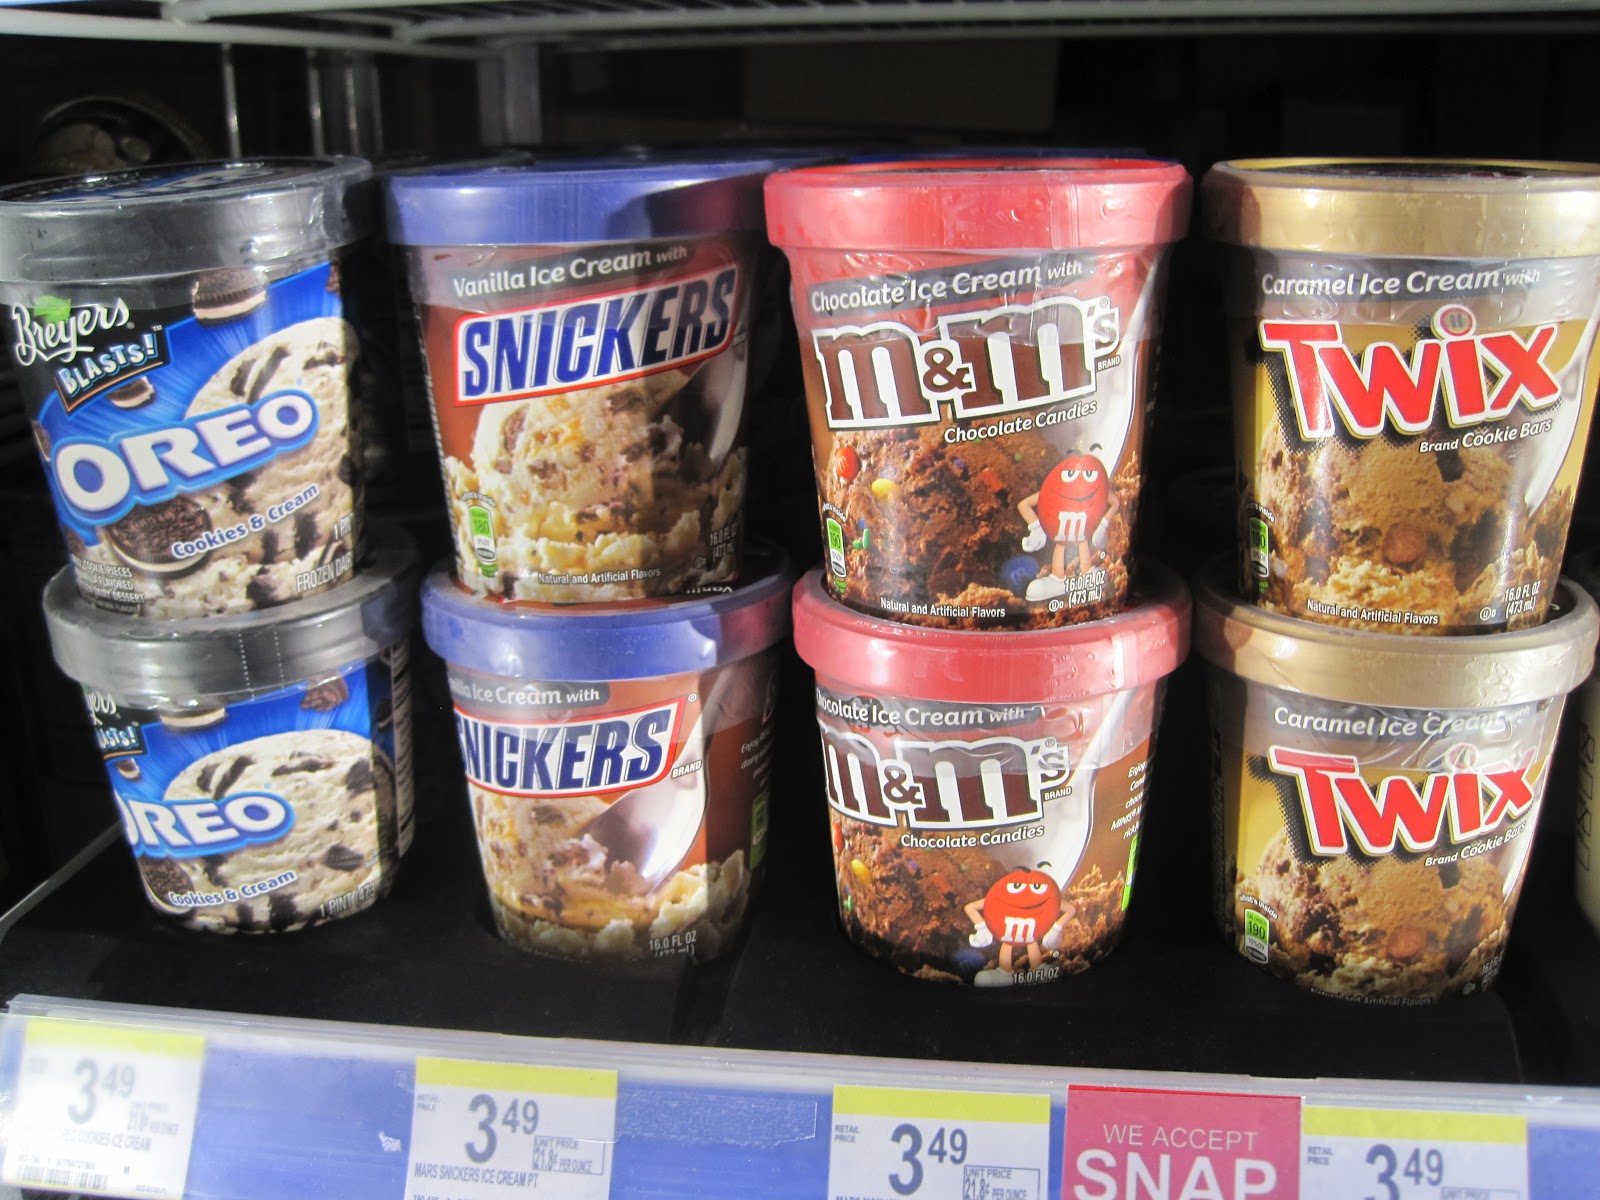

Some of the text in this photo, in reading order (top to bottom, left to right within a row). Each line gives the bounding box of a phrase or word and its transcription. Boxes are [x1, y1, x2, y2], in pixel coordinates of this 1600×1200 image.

[453, 246, 687, 298] Vanilla Ice Cream with
[1262, 269, 1541, 296] Caramel Ice Cream with
[812, 259, 1082, 313] Chocolate Ice Cream with
[11, 298, 129, 366] Breyers
[463, 268, 733, 397] SNICKERS
[1097, 355, 1121, 371] BRAND
[944, 401, 1097, 444] Chocolate Candies
[1419, 418, 1552, 454] Brand Cookie Bars
[56, 394, 313, 512] OREO
[173, 484, 318, 559] Cookies & Cream
[296, 562, 335, 593] FROZEN
[538, 567, 661, 585] Natural and Artificial Flavors
[1065, 570, 1105, 592] 16.0 FL OZ
[1069, 590, 1086, 608] (473
[1505, 580, 1541, 601] 16.0 FL OZ
[880, 597, 1006, 618] Natural and Artificial Flavors
[1307, 598, 1439, 625] Natural and Artificial Flavors
[1506, 600, 1523, 619] (473
[472, 683, 493, 702] Ice
[495, 687, 562, 704] Cream
[566, 689, 600, 702] with
[872, 705, 900, 724] Ice
[905, 707, 983, 726] Cream
[989, 706, 1025, 723] with
[1274, 706, 1374, 736] Caramel
[1379, 714, 1417, 736] Ice
[672, 760, 701, 778] BRAND
[1044, 786, 1072, 801] BRAND
[901, 825, 1044, 849] Chocolate Candies
[1425, 821, 1526, 867] Brand Cookie Bars
[169, 870, 296, 907] Cookies & Cream
[320, 903, 325, 918] 1
[328, 892, 354, 914] PINT
[1259, 900, 1278, 920] inside
[649, 937, 669, 951] 16.0
[672, 934, 683, 947] FL
[685, 930, 697, 944] OZ
[1248, 921, 1265, 939] 190
[1013, 967, 1059, 984] 16.0 FL OZ
[417, 1103, 436, 1112] PRICE
[834, 1125, 860, 1134] RETAIL
[834, 1134, 856, 1143] PRICE
[1103, 1124, 1258, 1152] WE ACCEPT
[535, 1137, 579, 1150] UNIT PRICE
[1307, 1146, 1334, 1156] RETAIL
[560, 1159, 571, 1170] PER
[573, 1161, 592, 1173] OUNCE
[1307, 1156, 1329, 1165] PRICE
[414, 1163, 539, 1188] MARS SNICKERS ICE CREAM PT
[965, 1168, 1012, 1179] UNIT PRICE
[1074, 1149, 1277, 1200] SNAP
[992, 1188, 1005, 1198] PER
[1006, 1189, 1027, 1200] OUNCE
